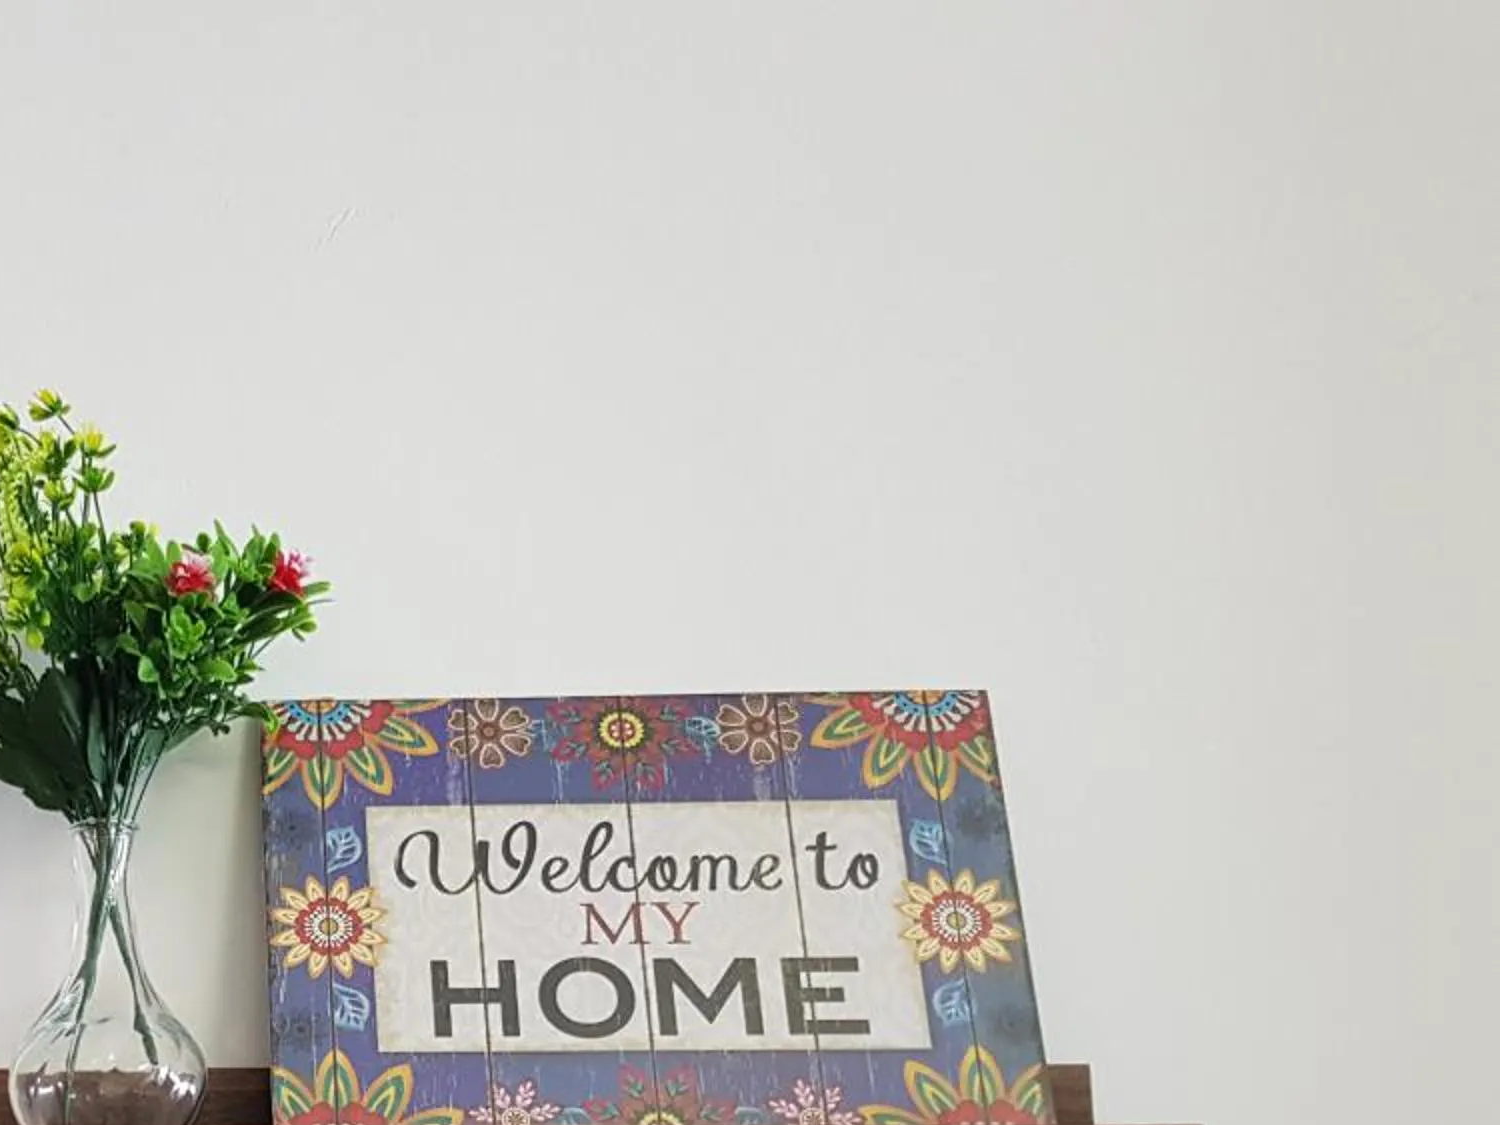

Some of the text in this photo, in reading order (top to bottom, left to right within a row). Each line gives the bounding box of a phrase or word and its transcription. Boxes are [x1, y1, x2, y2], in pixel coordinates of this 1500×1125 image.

[393, 820, 880, 895] Welcome to
[579, 902, 701, 945] MY
[429, 956, 872, 1039] HOME
